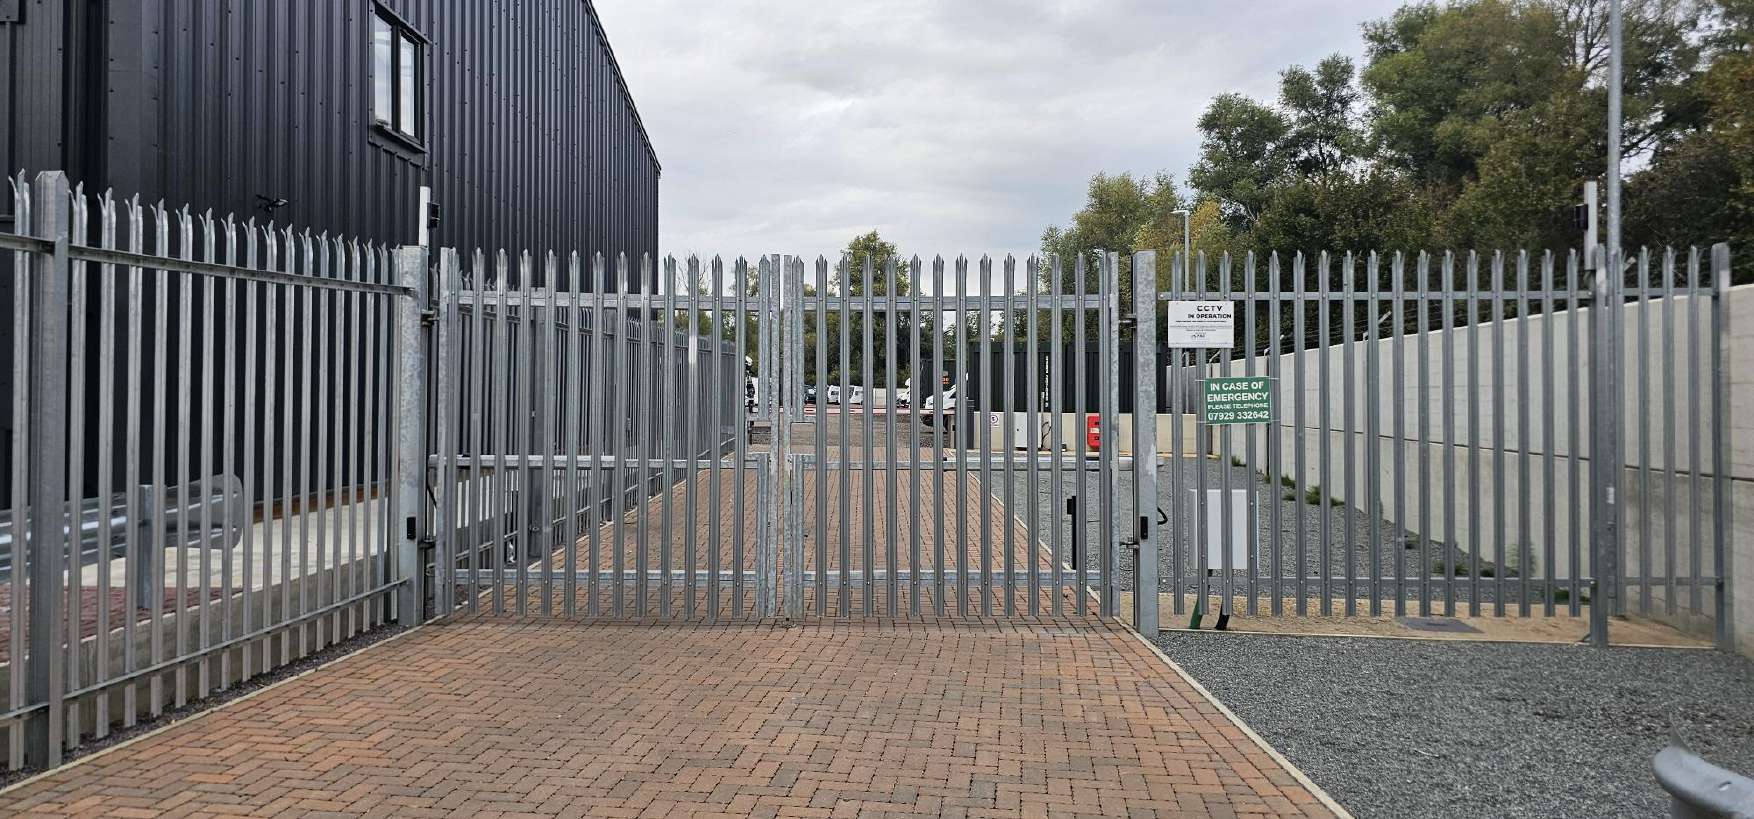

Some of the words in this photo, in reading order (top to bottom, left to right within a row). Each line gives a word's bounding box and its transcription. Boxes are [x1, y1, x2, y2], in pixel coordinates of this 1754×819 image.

[1210, 382, 1220, 391] IN
[1222, 382, 1249, 391] CASE
[1251, 381, 1264, 390] OF
[1207, 392, 1269, 402] EMERGENCY
[1208, 412, 1235, 421] 07929
[1237, 411, 1269, 420] 332642
